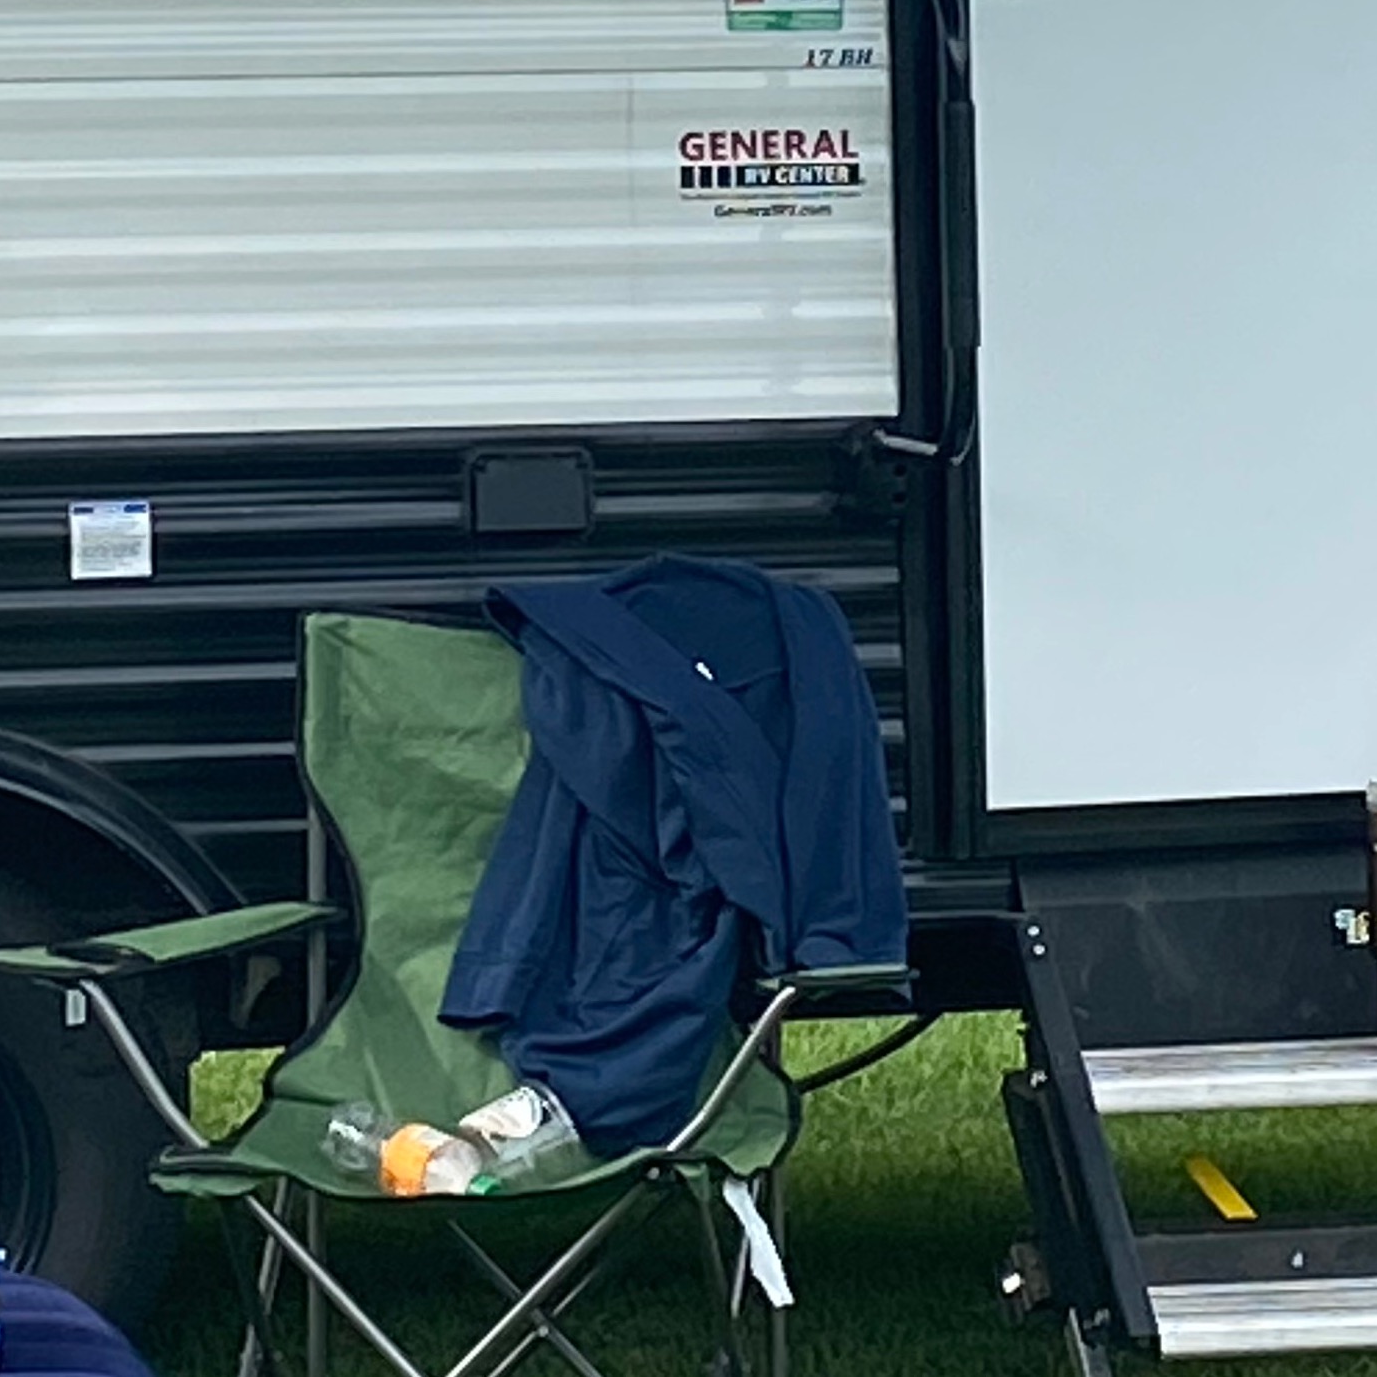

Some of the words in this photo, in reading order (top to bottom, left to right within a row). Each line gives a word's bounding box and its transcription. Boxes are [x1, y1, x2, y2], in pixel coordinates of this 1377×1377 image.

[805, 48, 835, 67] 17
[838, 48, 874, 67] BH
[678, 129, 860, 162] GENERAL
[743, 166, 771, 185] RV
[774, 165, 851, 184] CENTER
